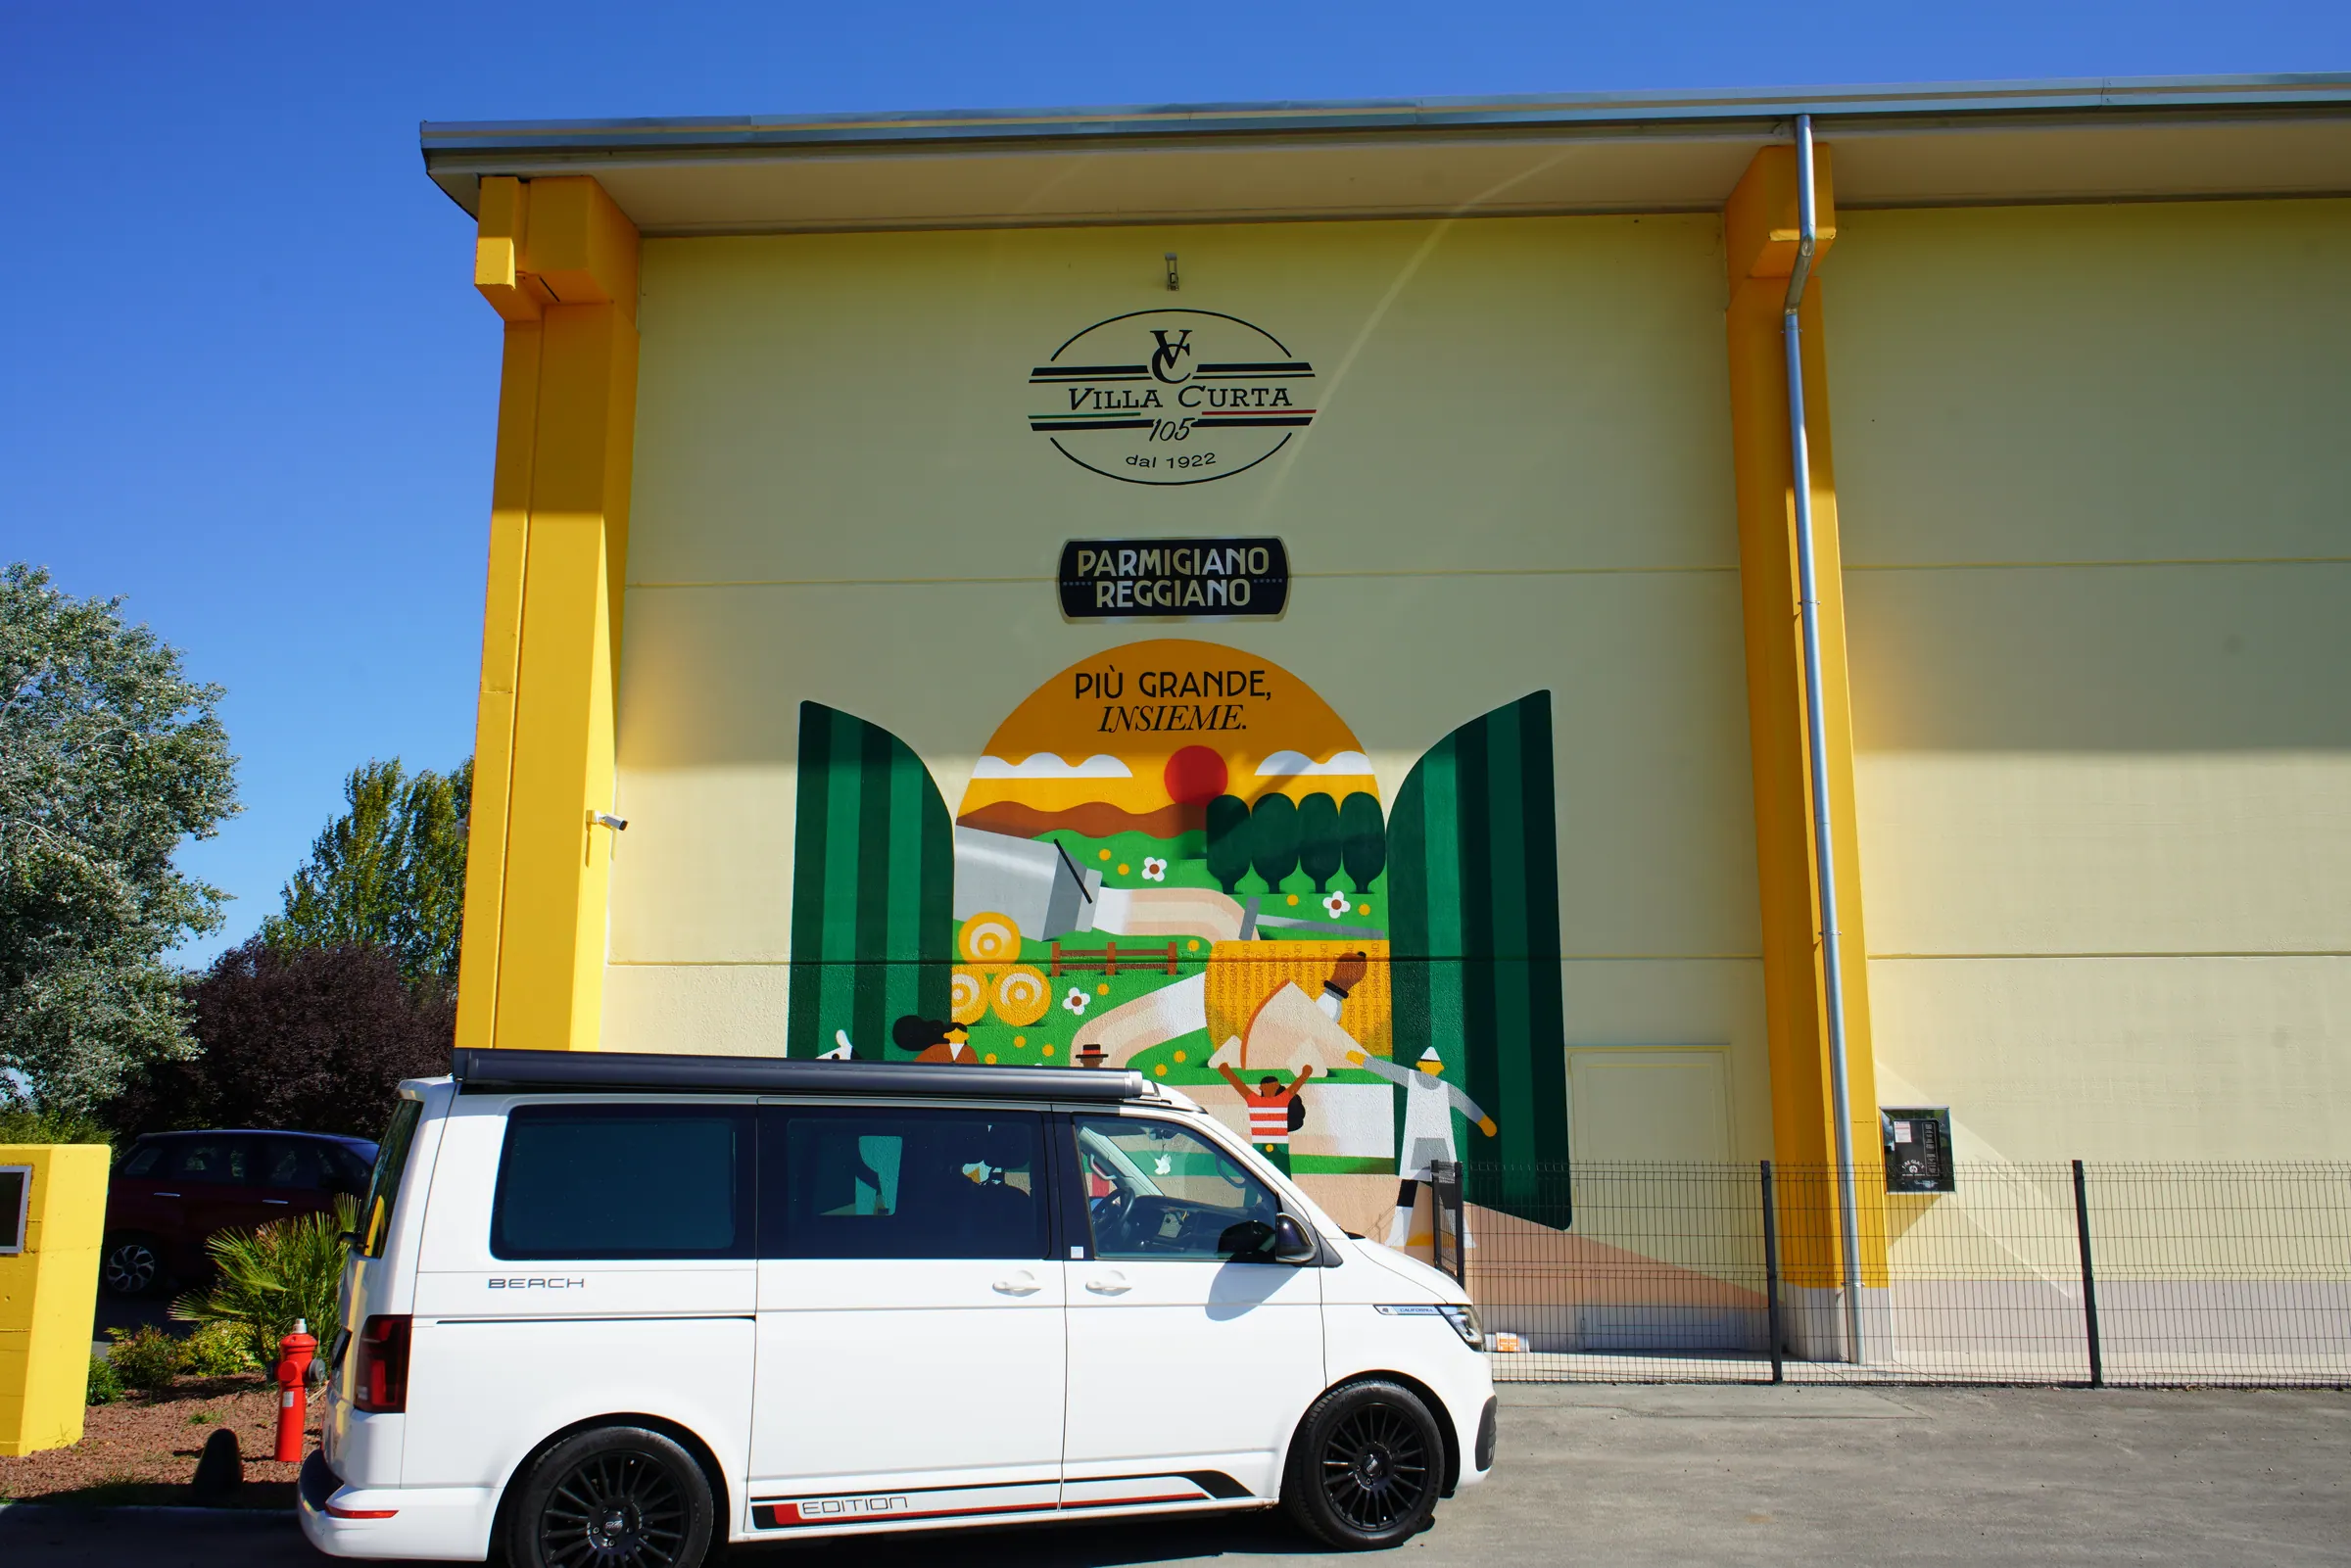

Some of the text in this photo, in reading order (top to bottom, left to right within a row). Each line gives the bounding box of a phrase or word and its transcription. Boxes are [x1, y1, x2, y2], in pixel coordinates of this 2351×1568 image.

[1069, 385, 1292, 410] VILLA CURTA
[1149, 417, 1196, 442] 105
[1126, 452, 1217, 469] dal 1922
[1078, 546, 1270, 577] PARMIGIANO
[1095, 578, 1251, 608] REGGIANO
[1075, 664, 1272, 700] PIÙ GRANDE,
[1097, 704, 1247, 734] INSIEME.
[488, 1278, 585, 1289] BEACH
[802, 1497, 909, 1514] EDITION
